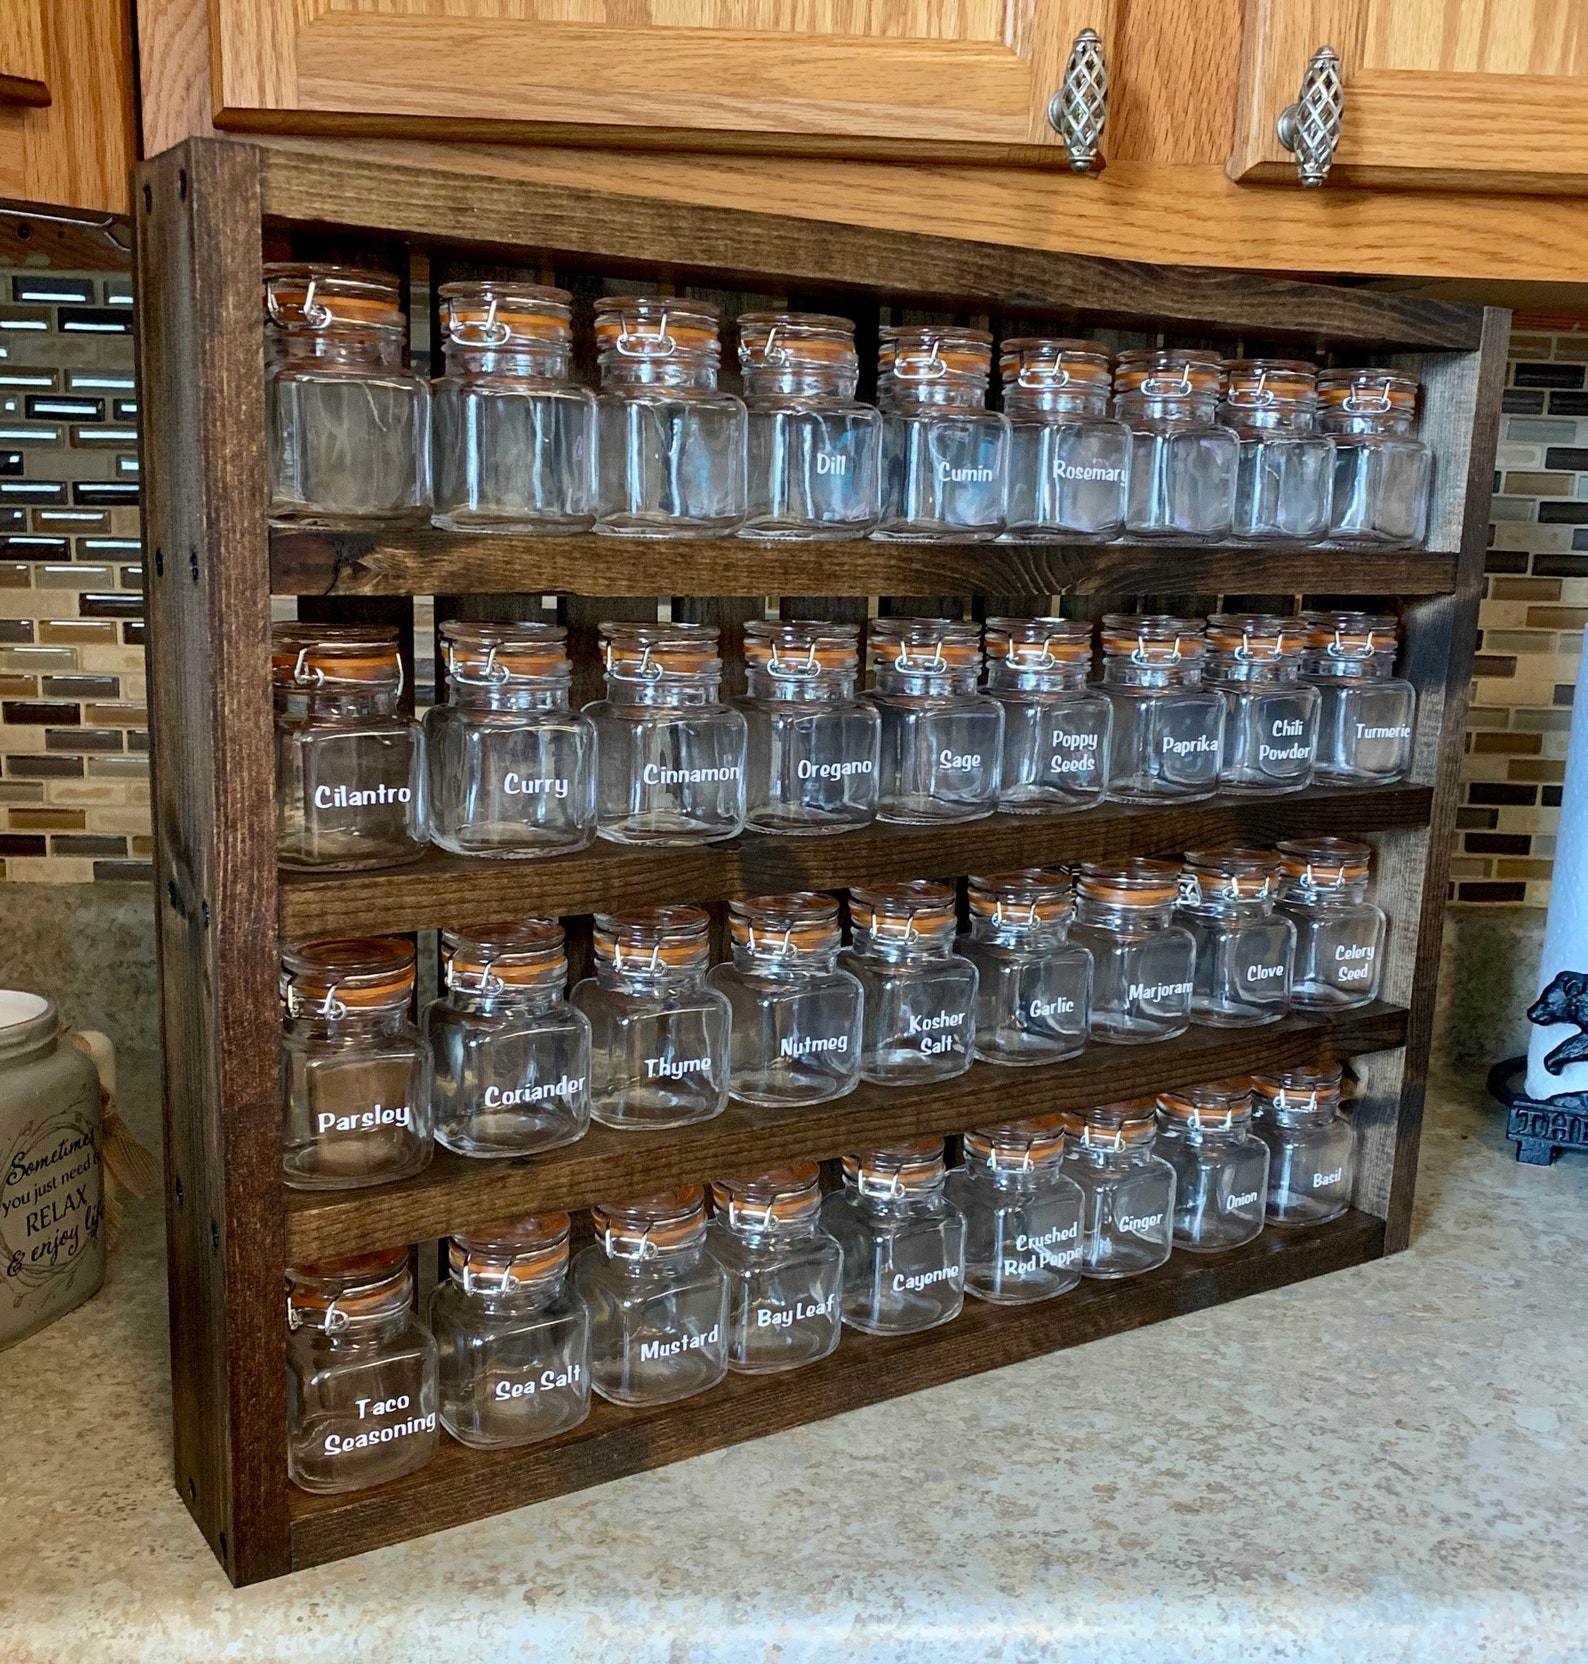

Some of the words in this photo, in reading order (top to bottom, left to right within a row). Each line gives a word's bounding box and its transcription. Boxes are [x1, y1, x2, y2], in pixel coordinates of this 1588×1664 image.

[816, 453, 846, 476] Dill
[938, 461, 994, 483] Cumin
[1052, 459, 1129, 487] Rosemary
[1271, 719, 1304, 738] Chili
[1355, 723, 1411, 741] Turmeric
[1051, 729, 1098, 752] Poppy
[1162, 733, 1220, 757] Paprika
[938, 749, 982, 770] Sage
[1049, 753, 1096, 774] Seeds
[1258, 744, 1312, 762] Powder
[643, 763, 740, 785] Cinnamon
[797, 758, 873, 782] Oregano
[314, 783, 411, 809] Cilantro
[503, 771, 569, 798] Curry
[1334, 944, 1375, 962] Celery
[1246, 963, 1285, 983] Clove
[1337, 963, 1369, 982] Seed
[1128, 982, 1194, 1003] Marjoram
[1029, 996, 1075, 1019] Garlic
[908, 1010, 966, 1032] Kosher
[779, 1034, 849, 1059] Nutmeg
[919, 1034, 954, 1057] Salt
[643, 1056, 712, 1080] Thyme
[484, 1074, 586, 1108] Coriander
[316, 1103, 411, 1134] Parsley
[1, 1190, 31, 1218] you
[33, 1176, 57, 1206] just
[61, 1153, 91, 1185] need
[1312, 1167, 1342, 1189] Basil
[25, 1184, 89, 1238] RELAX
[1226, 1190, 1258, 1211] Onion
[1118, 1210, 1164, 1233] Ginger
[31, 1224, 79, 1267] enjoy
[1015, 1221, 1078, 1252] Crushed
[1003, 1254, 1037, 1276] Red
[892, 1264, 960, 1293] Cayenne
[756, 1307, 794, 1328] Bay
[795, 1293, 836, 1321] Leaf
[640, 1324, 720, 1362] Mustard
[494, 1379, 535, 1401] Sea
[539, 1364, 582, 1392] Salt
[354, 1394, 410, 1420] Taco
[323, 1411, 436, 1457] Seasoning
